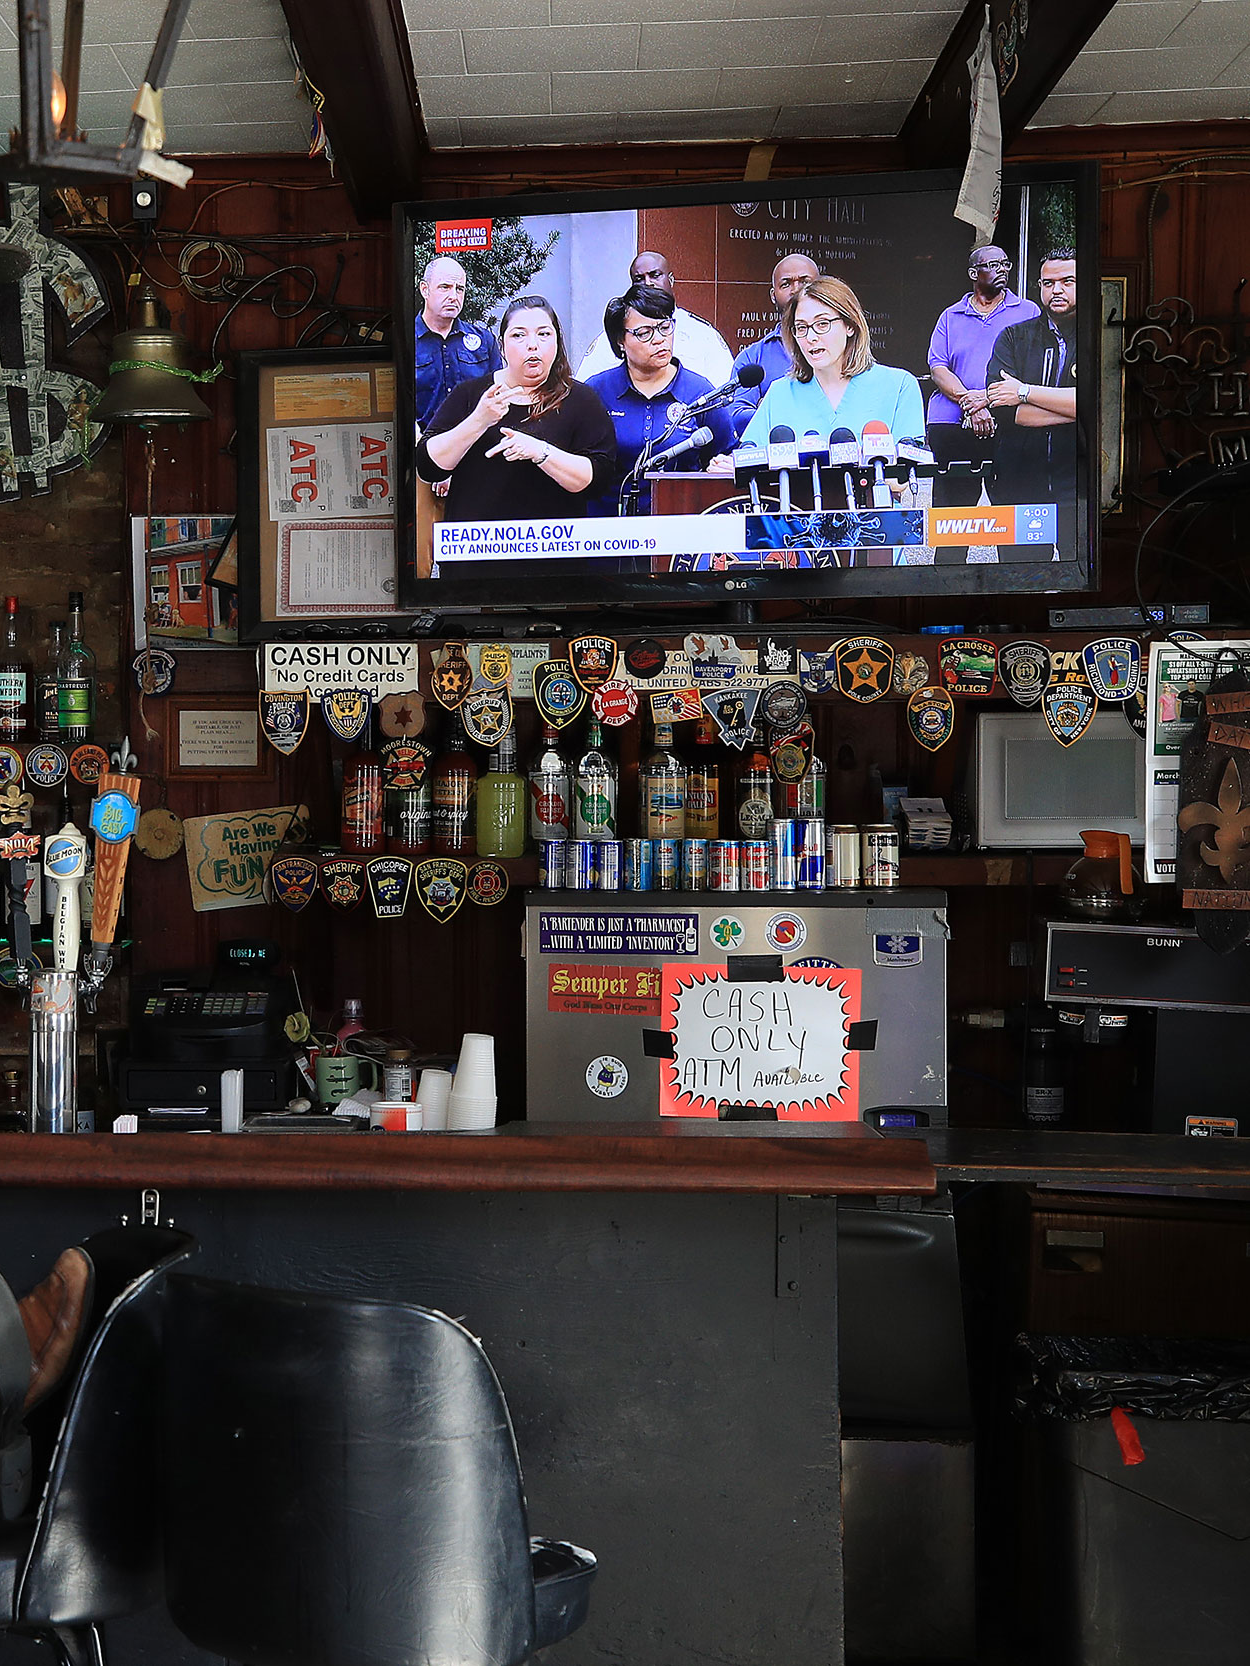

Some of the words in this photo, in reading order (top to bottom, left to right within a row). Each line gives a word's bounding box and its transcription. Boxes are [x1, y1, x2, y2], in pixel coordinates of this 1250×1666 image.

[440, 227, 487, 238] BREAKING
[440, 238, 467, 248] NEWS
[468, 237, 487, 246] LIVE
[290, 438, 318, 504] ATC
[360, 434, 389, 501] ATC
[1023, 508, 1049, 517] 4:00
[441, 525, 574, 542] READY.NOLA.GOV
[935, 519, 1007, 535] WWLTV.com
[1027, 531, 1043, 541] 83°
[441, 544, 466, 555] CITY
[468, 541, 539, 554] ANNOUNCES
[541, 540, 581, 553] LATEST
[584, 540, 600, 551] ON
[604, 538, 656, 551] COVID-19
[574, 639, 612, 653] POLICE
[847, 639, 884, 650] SHERIFF
[957, 641, 995, 655] CROSSE
[1091, 640, 1132, 653] POLICE
[271, 646, 339, 666] CASH
[347, 646, 412, 666] ONLY
[277, 669, 299, 683] No
[303, 669, 353, 683] Credit
[357, 669, 405, 683] Cards
[695, 666, 732, 674] DAVENPORT
[702, 671, 725, 679] POLICE
[647, 678, 688, 688] UNITED
[690, 678, 721, 688] CABS
[1088, 660, 1139, 698] RICHMOND-VIRGINIA
[947, 684, 988, 694] POLICE
[1056, 686, 1083, 694] POLICE
[714, 692, 748, 704] KANKAKEE
[1046, 692, 1092, 704] DEPARTMENT
[724, 727, 750, 740] POLICE
[380, 738, 433, 758] MOORESTOWN
[222, 826, 250, 842] Are
[253, 821, 277, 838] We
[2, 836, 37, 855] NOLA
[228, 838, 281, 857] Having
[213, 857, 265, 886] FUN
[322, 861, 363, 877] SHERIFF
[370, 861, 410, 874] CHICOPEE
[1156, 863, 1176, 873] VOTE
[378, 904, 402, 915] POLICE
[58, 896, 68, 946] BELGIAN
[541, 916, 549, 931] A
[550, 917, 595, 932] BARTENDER
[598, 917, 606, 932] IS
[607, 917, 624, 933] JUST
[626, 917, 633, 932] A
[633, 918, 686, 933] PHARMACIST
[576, 935, 584, 950] A
[586, 935, 623, 950] LIMITED
[626, 936, 676, 951] INVENTORY
[1146, 937, 1180, 947] BUNN
[551, 969, 629, 1001] Semper
[635, 972, 661, 998] Fi
[563, 1000, 581, 1010] God
[604, 1002, 621, 1011] Our
[622, 1002, 648, 1013] Corps
[702, 988, 793, 1027] CASH
[711, 1025, 807, 1070] ONLY
[683, 1057, 742, 1092] ATM
